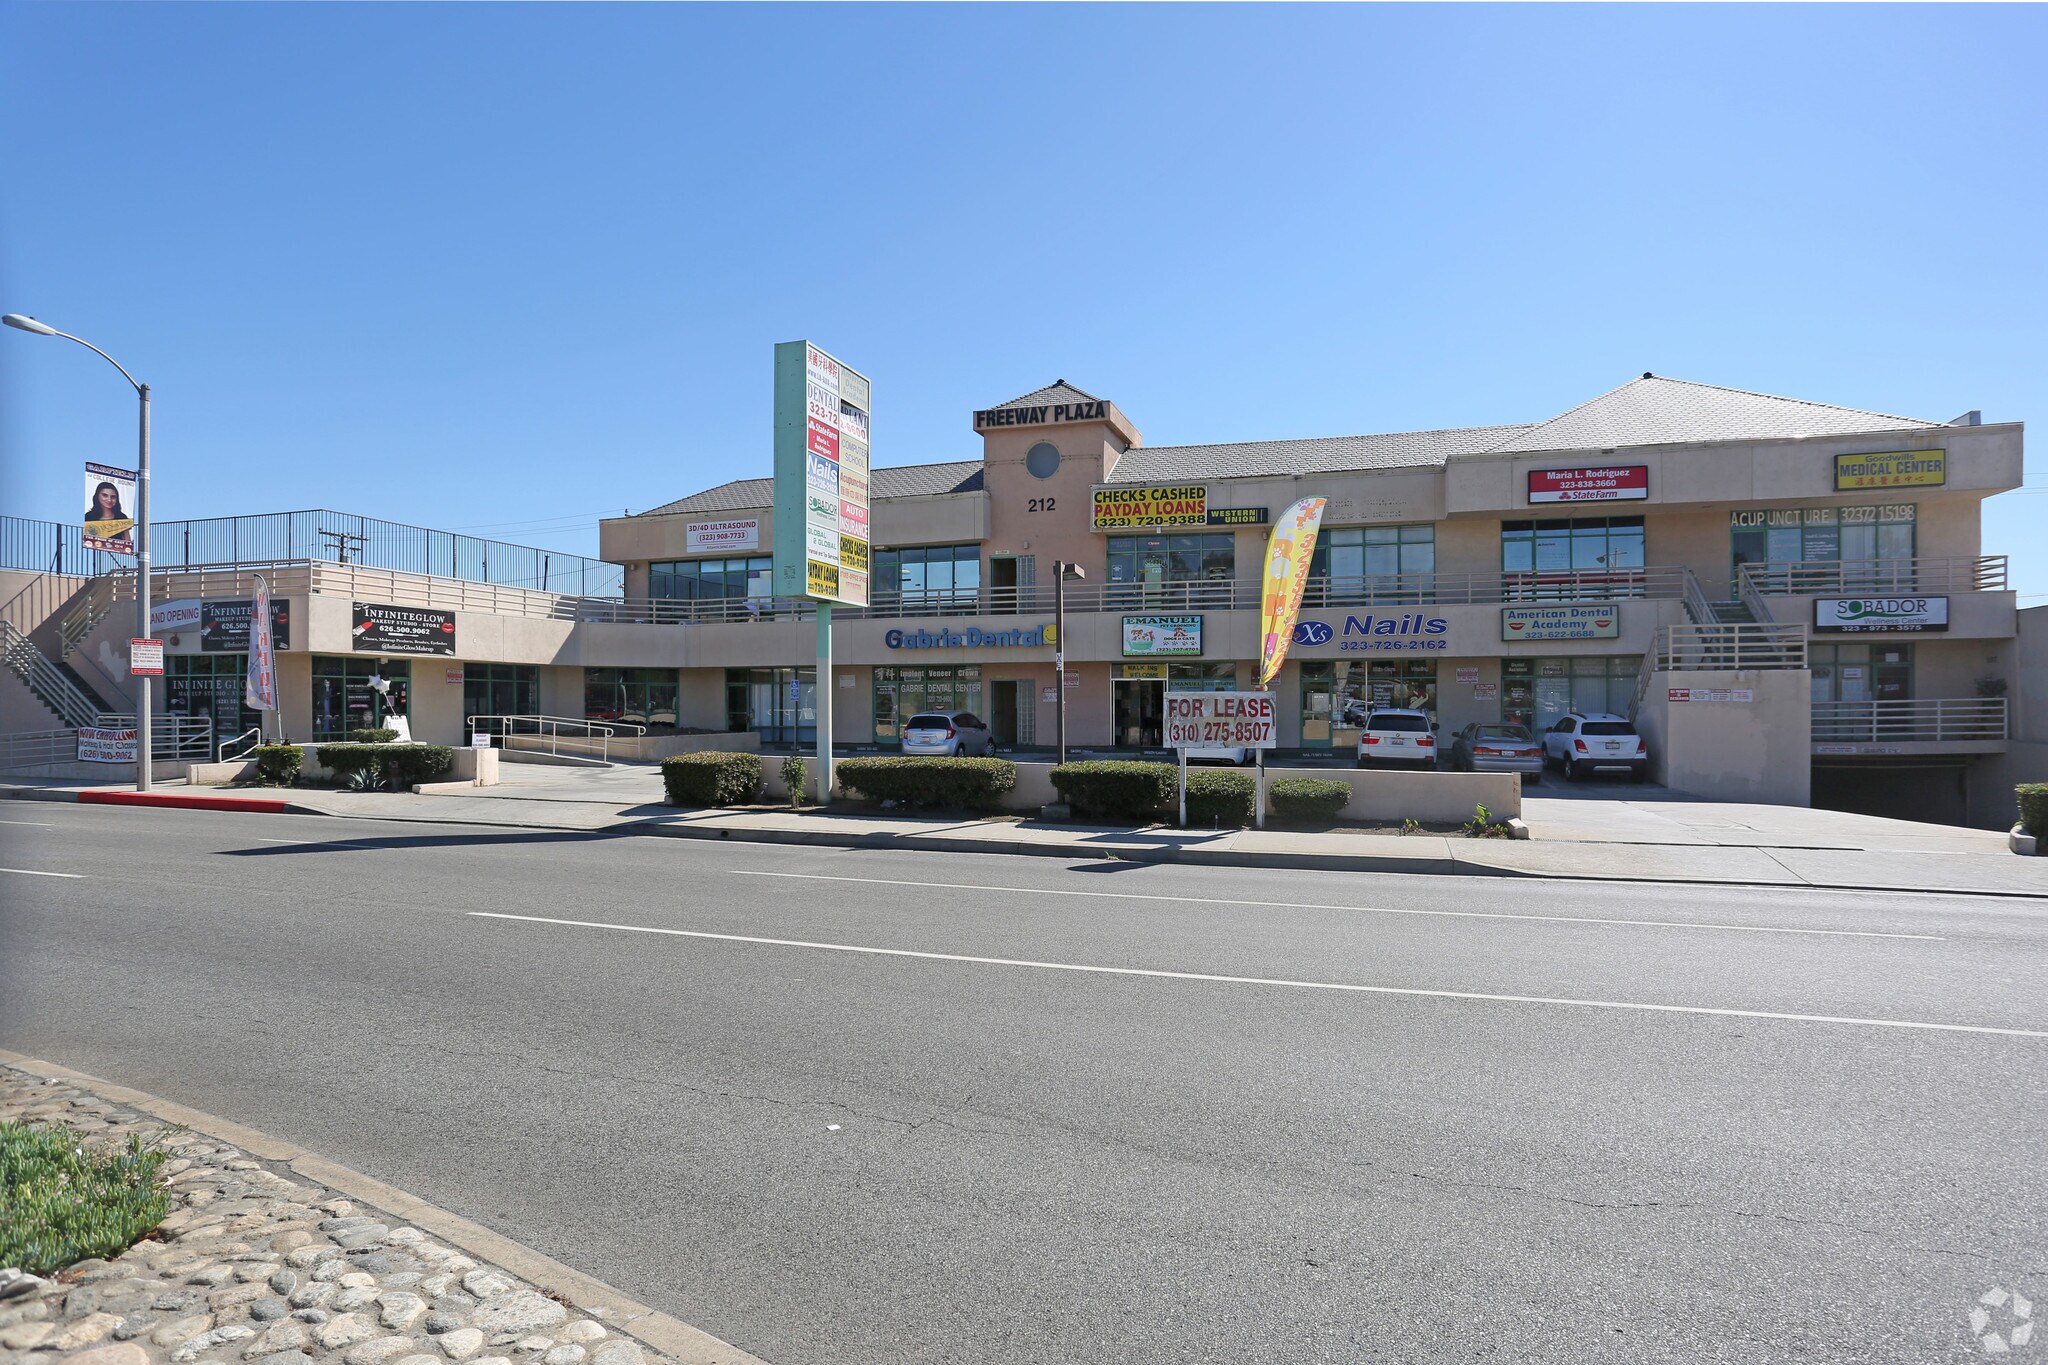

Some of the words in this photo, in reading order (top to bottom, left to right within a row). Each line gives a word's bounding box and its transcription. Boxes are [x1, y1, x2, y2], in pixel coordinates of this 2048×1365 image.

[808, 383, 838, 413] DENTAL
[977, 406, 1048, 428] FREEWAY
[1054, 402, 1106, 422] PLAZA
[845, 454, 865, 469] SCHOOL
[1865, 454, 1915, 462] Goodwills
[808, 455, 838, 482] Nails
[1547, 471, 1572, 480] Maria
[1575, 471, 1583, 479] L.
[1586, 469, 1630, 479] Rodriguez
[1839, 462, 1892, 477] MEDICAL
[1896, 459, 1942, 474] CENTER
[1560, 480, 1617, 489] 323-838-3660
[1094, 489, 1146, 504] CHECKS
[1151, 487, 1206, 501] CASHED
[1572, 490, 1618, 500] StateFarm
[808, 495, 838, 514] SOBADOR
[1028, 497, 1056, 513] 212
[1094, 502, 1152, 518] PAYDAY
[1155, 500, 1206, 515] LOANS
[846, 505, 864, 518] AUTO
[711, 522, 757, 531] ULTRASOUND
[1094, 517, 1131, 528] (323)
[1137, 515, 1206, 525] 720-9388
[1225, 516, 1256, 524] UNION
[808, 527, 827, 540] GLOBAL
[841, 517, 867, 538] INSURANCE
[699, 534, 716, 542] (323)
[818, 539, 837, 550] GLOBAL
[1508, 609, 1567, 620] American
[1571, 606, 1614, 618] Dental
[1838, 599, 1928, 614] SOBADOR
[167, 607, 200, 622] OPENING
[365, 609, 446, 623] INFINITEGLOW
[1126, 616, 1199, 625] EMANUEL
[379, 625, 431, 635] 626.500.9062
[1342, 613, 1449, 636] Nails
[1531, 619, 1587, 631] Academy
[885, 628, 964, 649] Gabrie
[966, 625, 1045, 649] Dental
[1525, 630, 1594, 639] 323-622-6688
[1340, 640, 1448, 651] 323-726-2162
[900, 670, 924, 679] Implant
[958, 669, 979, 677] Crown
[901, 684, 925, 693] GABRIE
[927, 684, 952, 693] DENTAL
[955, 683, 981, 692] CENTER
[1168, 698, 1204, 718] FOR
[1213, 698, 1271, 718] LEASE
[1169, 722, 1200, 742] (310)
[1203, 721, 1271, 742] 275-8507
[103, 741, 114, 750] Hair
[80, 749, 99, 760] (626)
